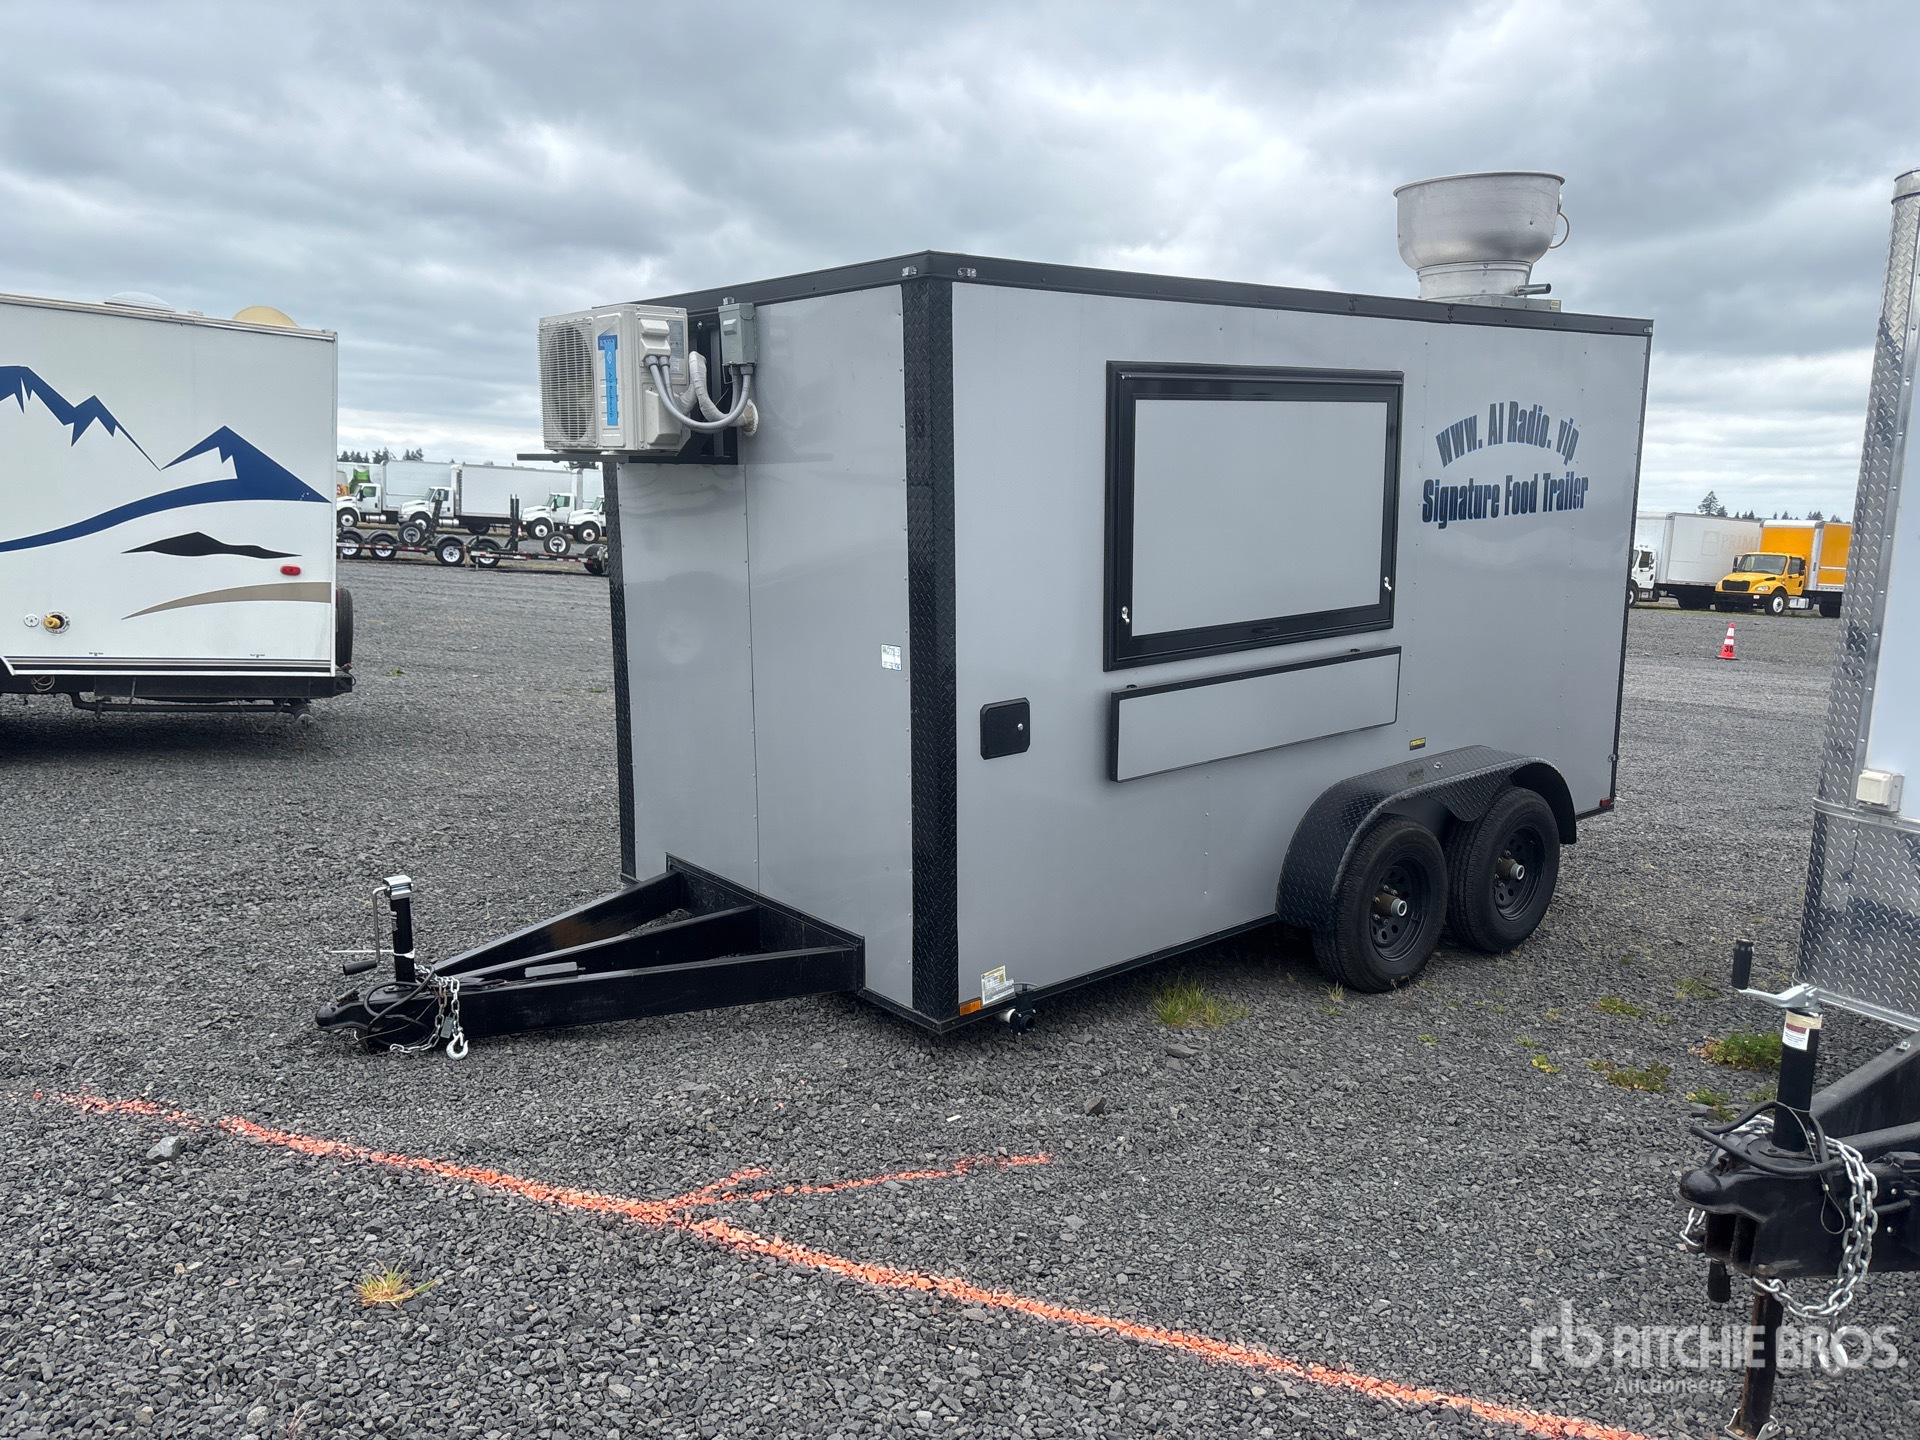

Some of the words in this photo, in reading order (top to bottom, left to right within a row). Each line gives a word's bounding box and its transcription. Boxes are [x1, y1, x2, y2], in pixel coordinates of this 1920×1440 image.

[1422, 478, 1500, 530] Signature
[1504, 473, 1539, 516] Food
[1543, 471, 1589, 512] Trailer
